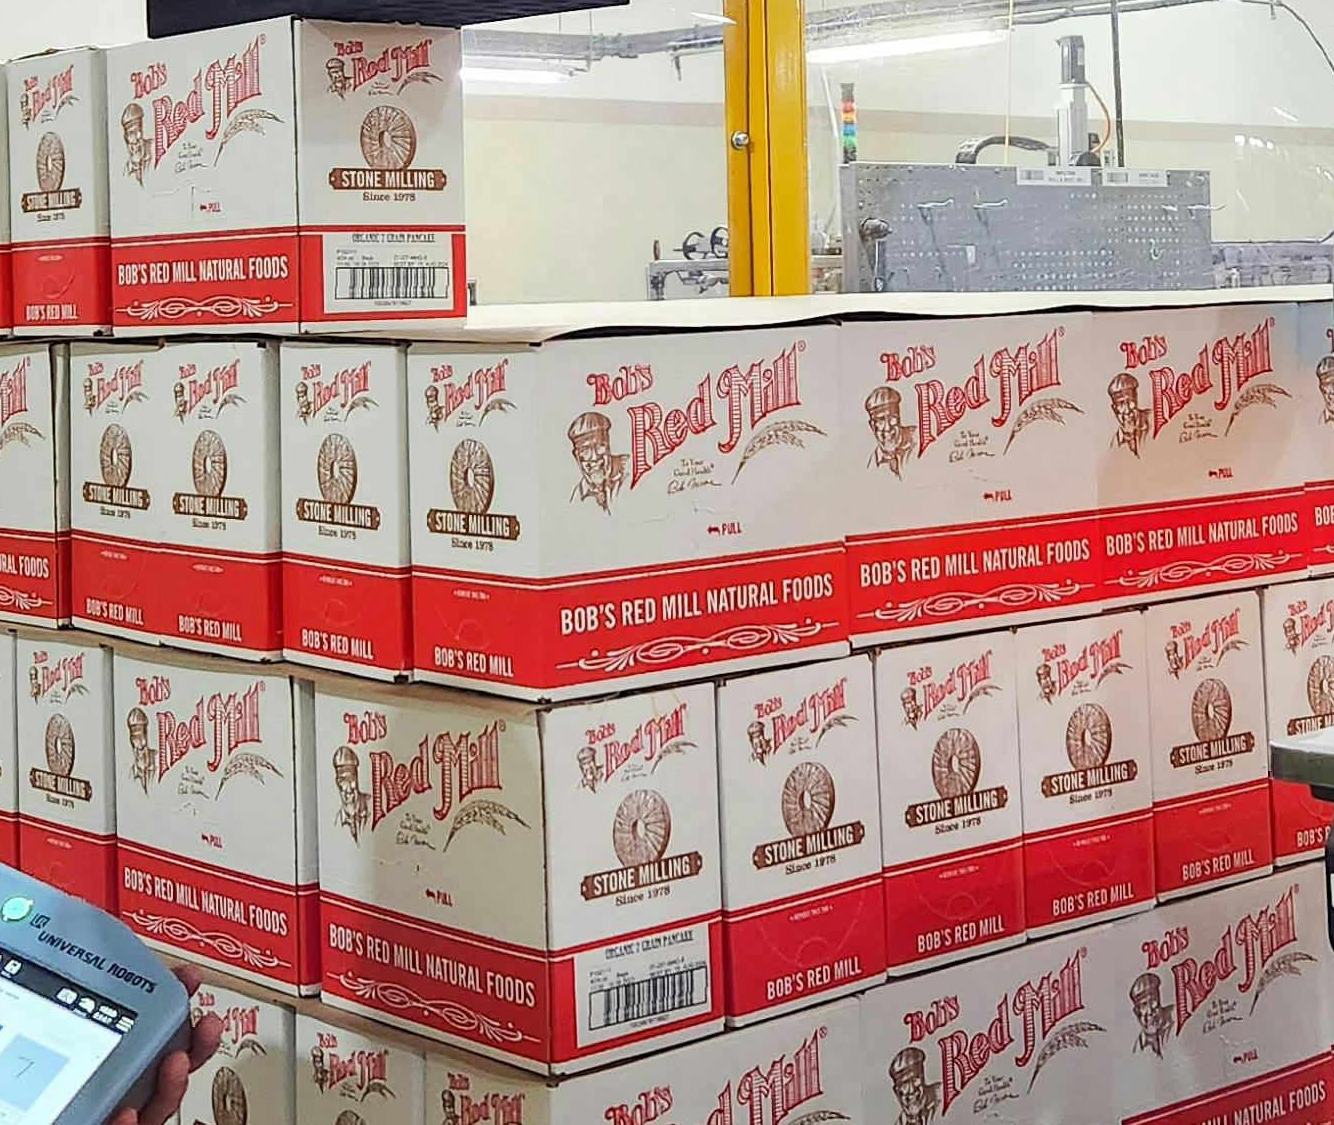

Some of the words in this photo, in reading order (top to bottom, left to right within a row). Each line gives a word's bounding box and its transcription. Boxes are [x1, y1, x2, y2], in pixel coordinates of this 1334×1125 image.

[352, 49, 391, 91] Red
[390, 40, 432, 82] Mill
[130, 63, 167, 99] Bob's
[152, 69, 204, 169] Red
[341, 170, 383, 188] STONE
[385, 170, 435, 188] MILLING
[362, 192, 390, 202] Since
[393, 192, 416, 202] 1978
[118, 263, 148, 285] BOB'S
[149, 262, 171, 284] RED
[172, 261, 197, 283] MILL
[198, 258, 246, 282] NATURAL
[248, 256, 288, 279] FOODS
[880, 345, 936, 381] Bob's
[914, 353, 991, 458] Red
[1120, 334, 1167, 370] Bob's
[1151, 342, 1212, 440] Red
[587, 363, 653, 406] Bob's
[627, 373, 716, 490] Red
[302, 501, 332, 522] STONE
[334, 505, 372, 526] MILLING
[435, 513, 466, 534] STONE
[468, 516, 510, 538] MILLING
[721, 522, 742, 535] PULL
[1106, 531, 1145, 556] BOB'S
[1148, 528, 1173, 552] RED
[1176, 524, 1205, 549] MILL
[1209, 517, 1258, 544] NATURAL
[1261, 512, 1298, 537] FOODS
[18, 556, 49, 578] FOODS
[860, 560, 906, 588] BOB'S
[911, 556, 940, 581] RED
[944, 551, 977, 577] MILL
[982, 540, 1044, 573] NATURAL
[1048, 537, 1089, 563] FOODS
[560, 604, 616, 635] BOB'S
[621, 599, 656, 626] RED
[662, 593, 701, 620] MILL
[707, 582, 778, 614] NATURAL
[782, 574, 833, 602] FOODS
[301, 628, 327, 652] BOB'S
[330, 633, 349, 655] RED
[351, 636, 373, 660] MILL
[434, 646, 463, 671] BOB'S
[465, 650, 487, 673] RED
[489, 653, 514, 677] MILL
[136, 676, 170, 706] Bob's
[157, 698, 207, 780] Red
[344, 712, 387, 744] Bob's
[370, 737, 431, 832] Red
[916, 801, 952, 824] STONE
[954, 791, 997, 815] MILLING
[764, 839, 802, 864] STONE
[805, 827, 853, 857] MILLING
[593, 867, 634, 896] STONE
[638, 858, 690, 889] MILLING
[615, 891, 644, 906] Since
[647, 885, 670, 900] 1978
[124, 867, 152, 894] BOB'S
[154, 875, 173, 899] RED
[176, 879, 198, 908] MILL
[201, 888, 246, 924] NATURAL
[249, 904, 288, 936] FOODS
[1052, 894, 1084, 916] BOB'S
[1087, 890, 1107, 910] RED
[1110, 884, 1134, 906] MILL
[918, 930, 952, 953] BOB'S
[955, 923, 975, 946] RED
[979, 915, 1004, 939] MILL
[38, 930, 104, 970] UNIVERSAL
[107, 963, 156, 994] ROBOTS
[329, 924, 363, 953] BOB'S
[366, 935, 390, 961] RED
[393, 941, 420, 969] MILL
[426, 950, 483, 993] NATURAL
[486, 971, 535, 1007] FOODS
[767, 974, 803, 1000] BOB'S
[807, 966, 830, 990] RED
[834, 957, 861, 985] MILL
[1142, 926, 1189, 968] Bob's
[1173, 925, 1236, 1036] Red
[904, 995, 960, 1042] Bob's
[940, 996, 1013, 1117] Red
